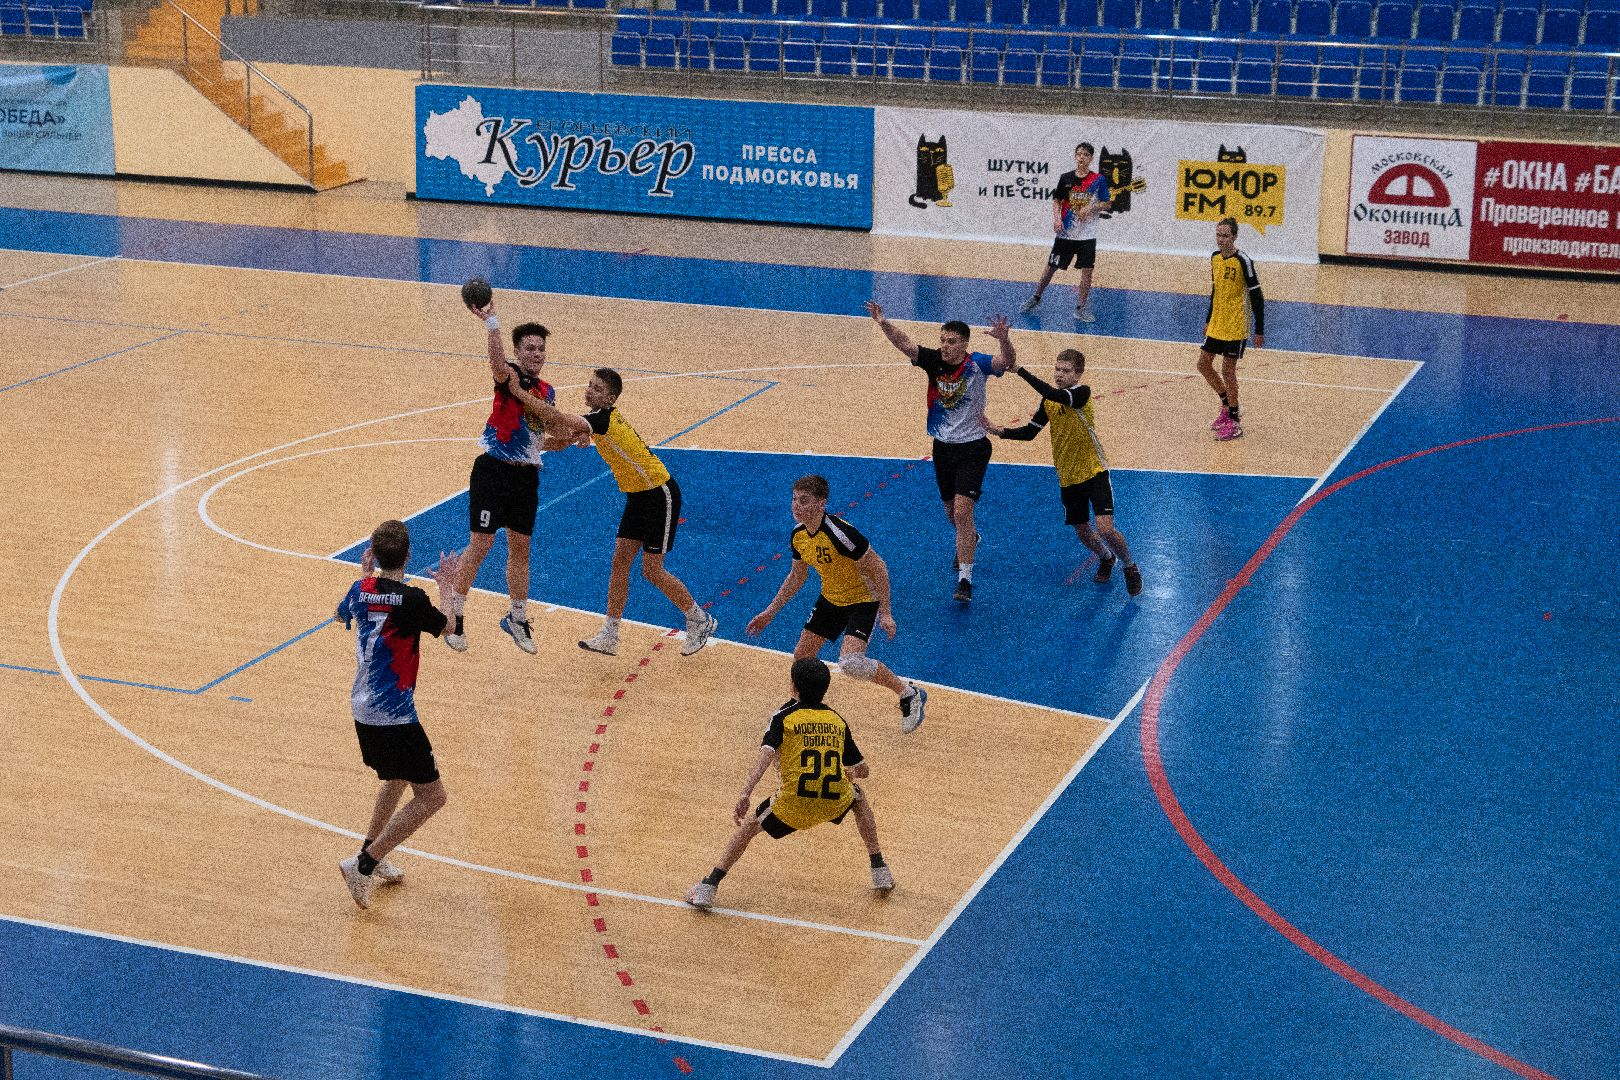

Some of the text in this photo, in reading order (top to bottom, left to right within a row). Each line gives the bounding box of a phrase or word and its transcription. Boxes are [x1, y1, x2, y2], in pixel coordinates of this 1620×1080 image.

[475, 117, 695, 197] Курьер
[742, 144, 817, 165] ПРЕССА
[702, 164, 859, 190] ПОДМОСКОВЬЯ
[987, 159, 1049, 174] ШУТКИ
[1484, 160, 1568, 192] #ОКНА
[1184, 168, 1278, 199] ЮМОР
[1183, 193, 1226, 214] FM
[1244, 204, 1276, 217] 89.7
[1481, 197, 1610, 229] Проверенное
[1223, 266, 1236, 281] 23
[480, 509, 491, 528] 9
[816, 546, 832, 564] 25
[363, 610, 390, 663] 7
[796, 749, 842, 801] 22
